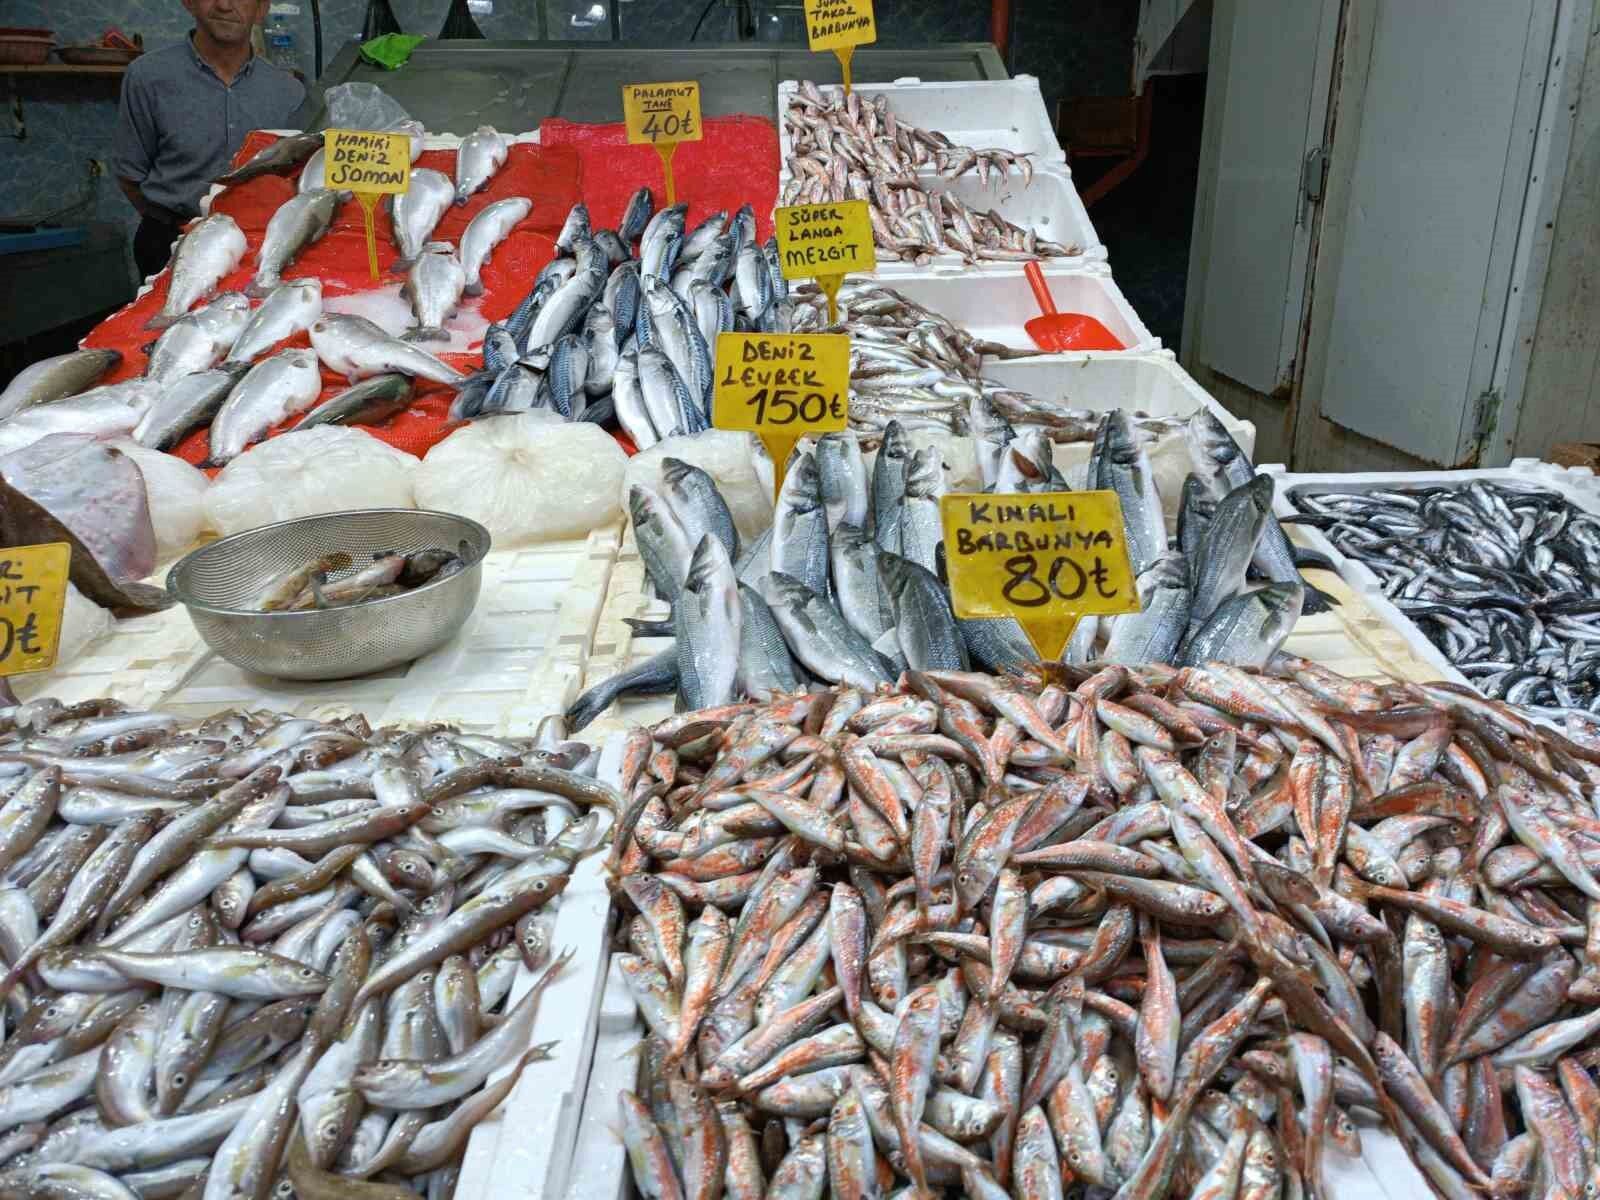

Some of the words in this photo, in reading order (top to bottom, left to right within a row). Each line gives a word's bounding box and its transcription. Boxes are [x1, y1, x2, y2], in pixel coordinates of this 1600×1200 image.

[811, 16, 871, 40] BARBUNYA
[633, 86, 695, 99] PALAMUT
[642, 98, 673, 109] TANE
[331, 164, 404, 184] SOMON
[789, 208, 844, 226] SÜPER
[789, 225, 844, 242] LANGA
[721, 365, 825, 388] LEVREK
[970, 502, 1076, 524] KINALI
[957, 527, 1113, 555] BARBUNYA
